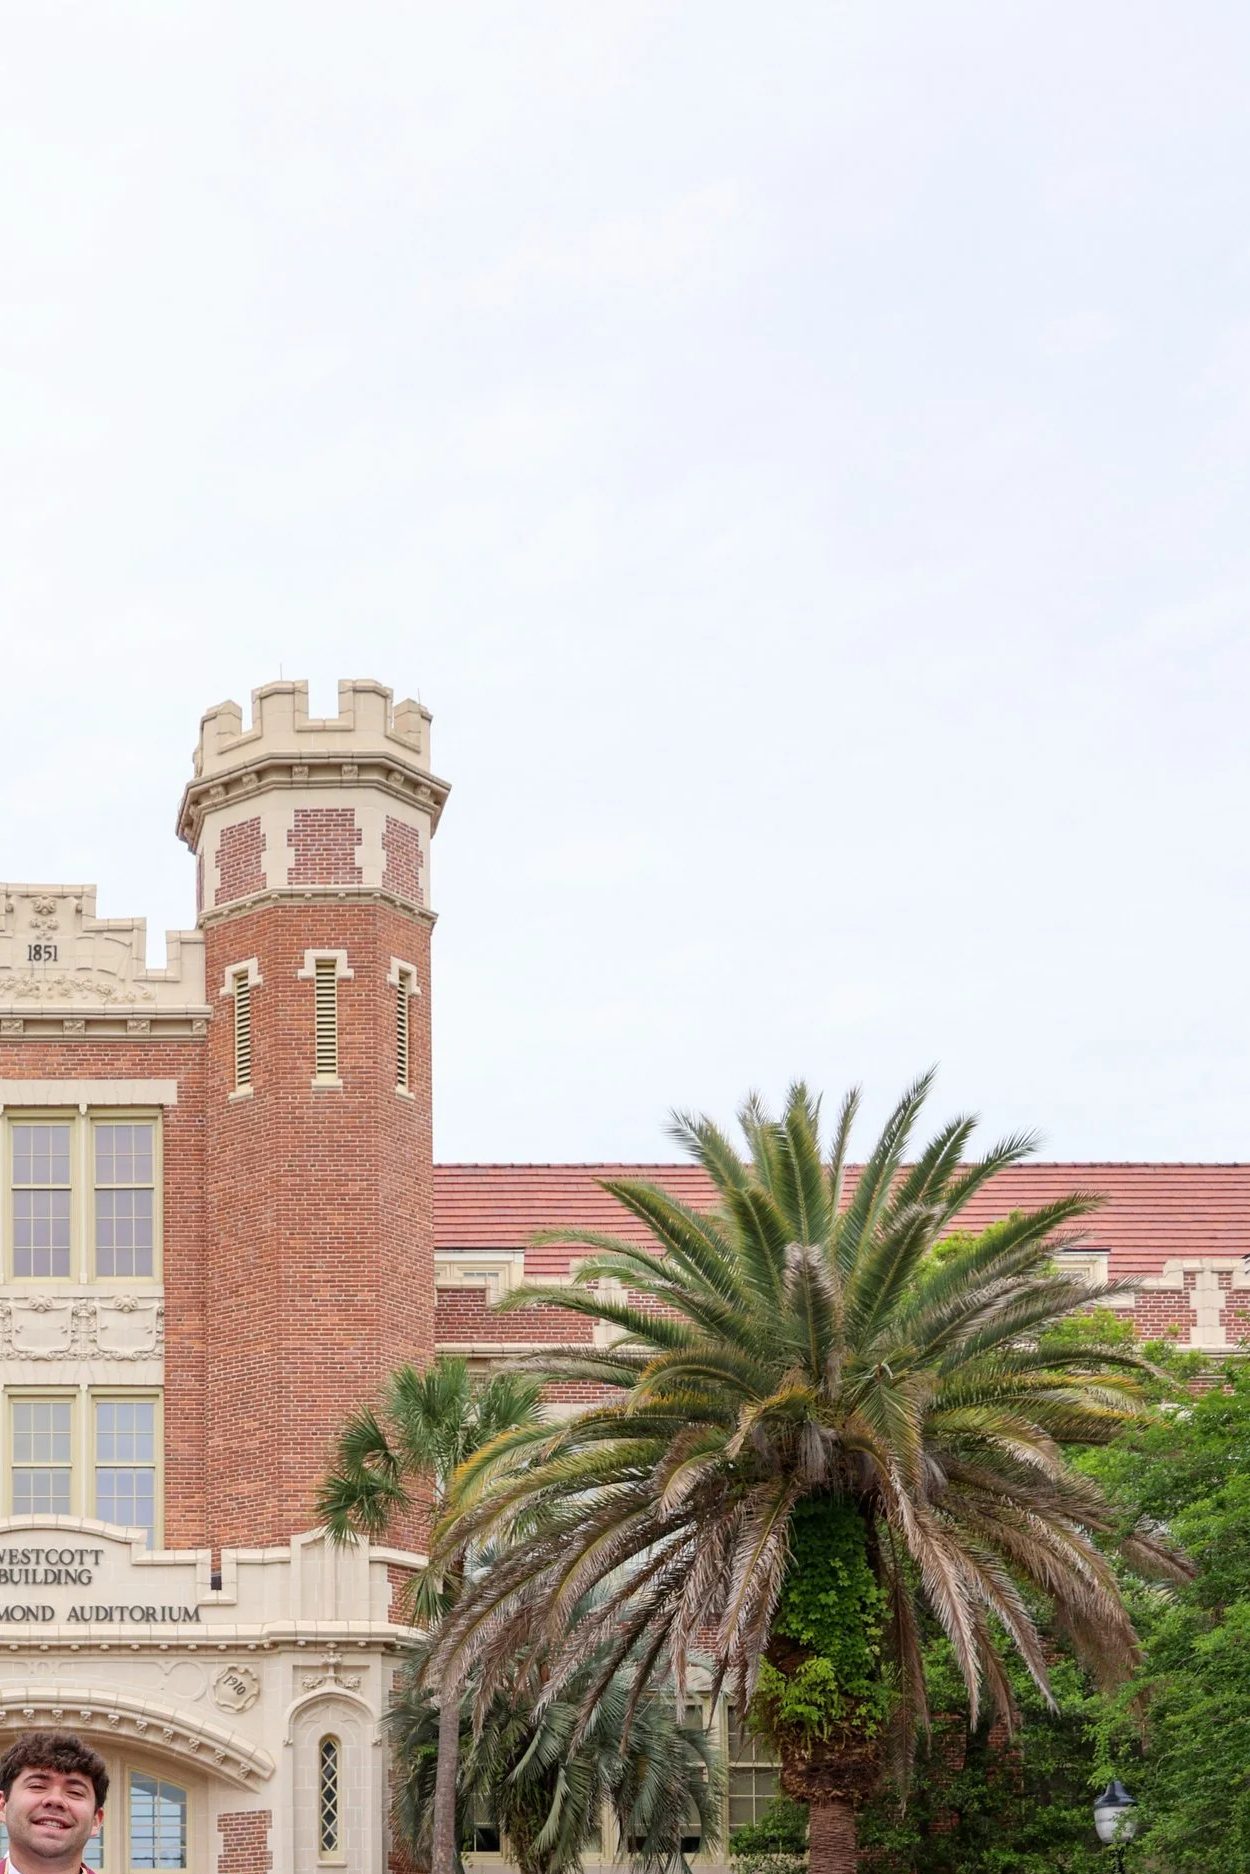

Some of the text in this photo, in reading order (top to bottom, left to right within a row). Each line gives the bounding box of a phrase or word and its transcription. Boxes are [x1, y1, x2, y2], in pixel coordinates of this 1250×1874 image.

[27, 944, 58, 962] 1851
[66, 1605, 201, 1622] AUDITORIUM
[223, 1675, 246, 1696] 1910
